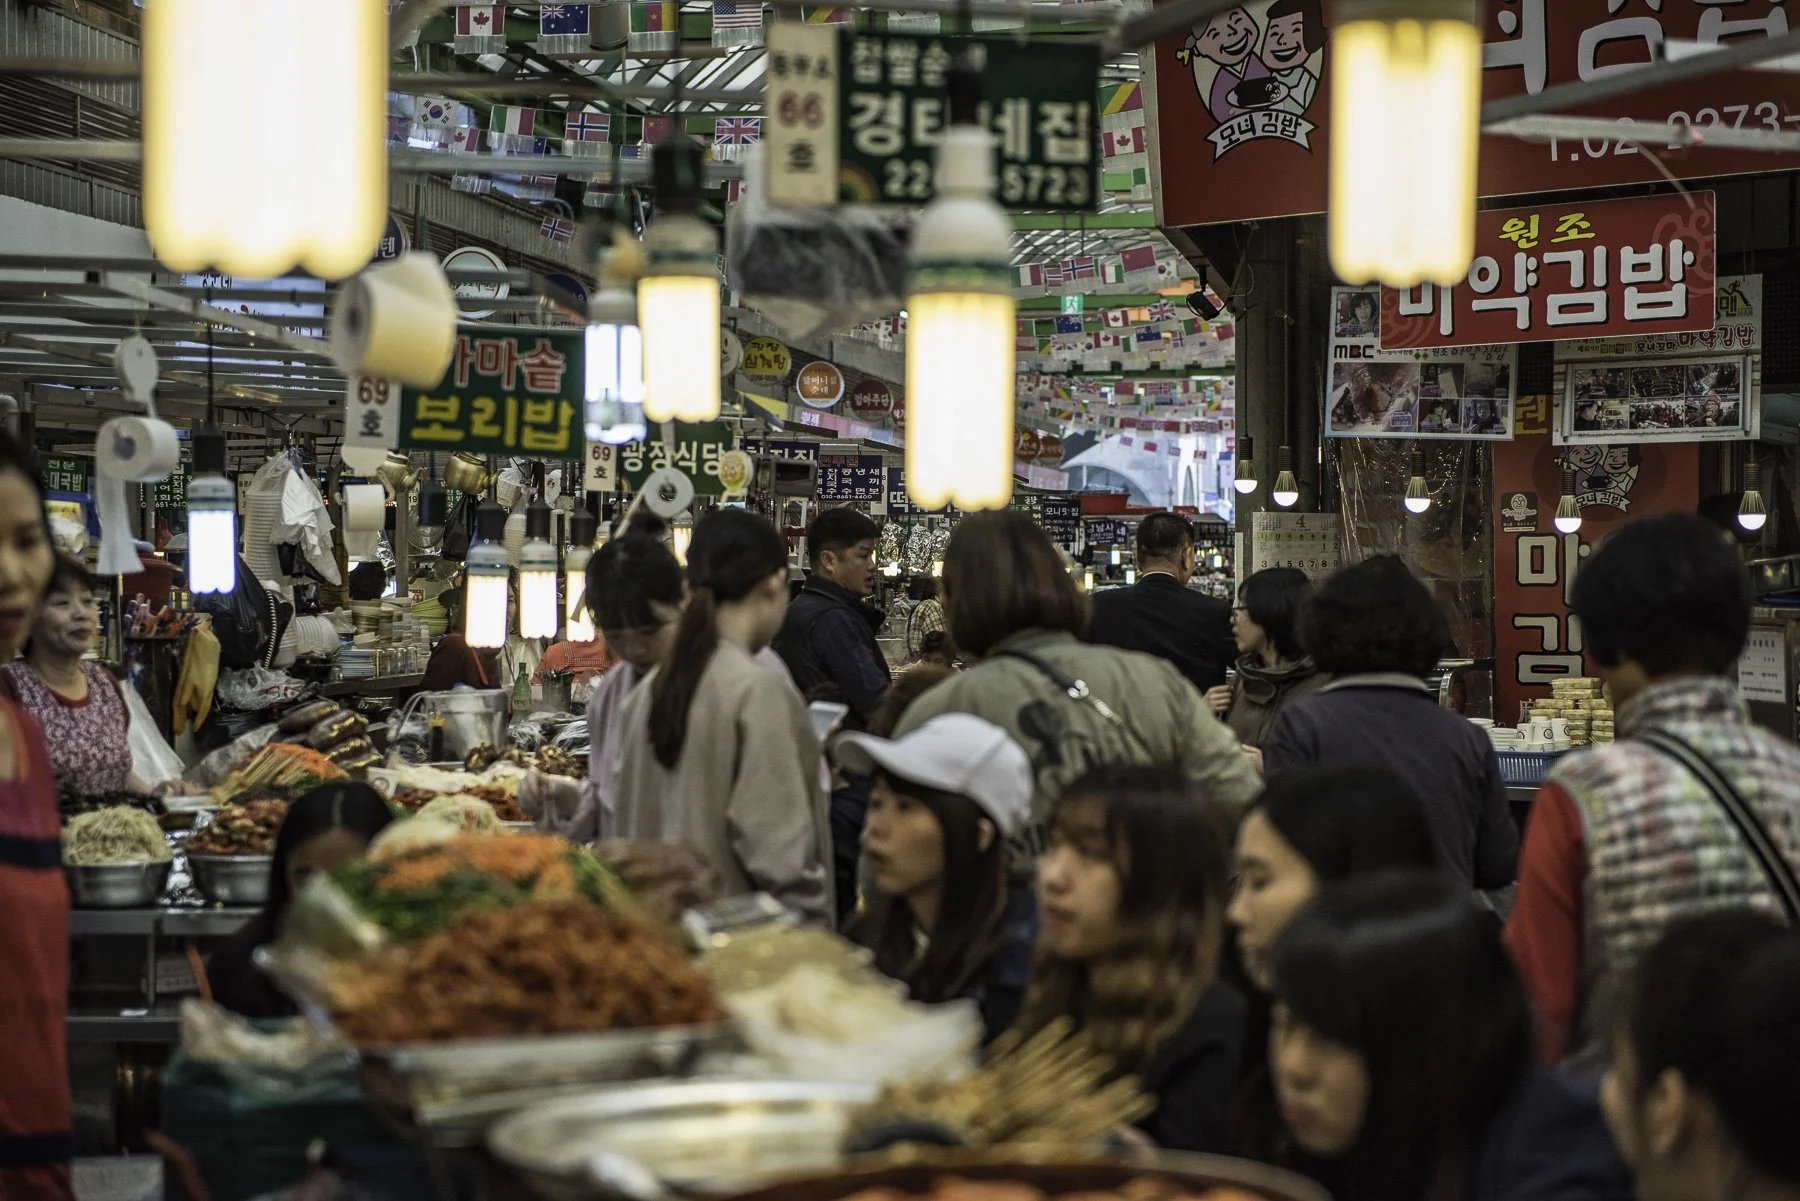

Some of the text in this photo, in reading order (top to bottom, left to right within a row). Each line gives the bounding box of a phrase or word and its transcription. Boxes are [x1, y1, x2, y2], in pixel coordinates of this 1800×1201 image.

[777, 90, 825, 130] 66
[1219, 111, 1303, 150] 모녀 김밥
[1333, 344, 1374, 359] MBC
[356, 375, 391, 406] 69
[358, 409, 385, 438] 호
[410, 395, 577, 451] 보리밥
[592, 446, 611, 461] 69
[1296, 514, 1306, 528] 4
[1261, 560, 1268, 568] 3
[1275, 560, 1282, 568] 4
[1287, 560, 1293, 568] 5
[1298, 560, 1304, 568] 6
[1310, 560, 1316, 568] 7
[1321, 560, 1328, 568] 8
